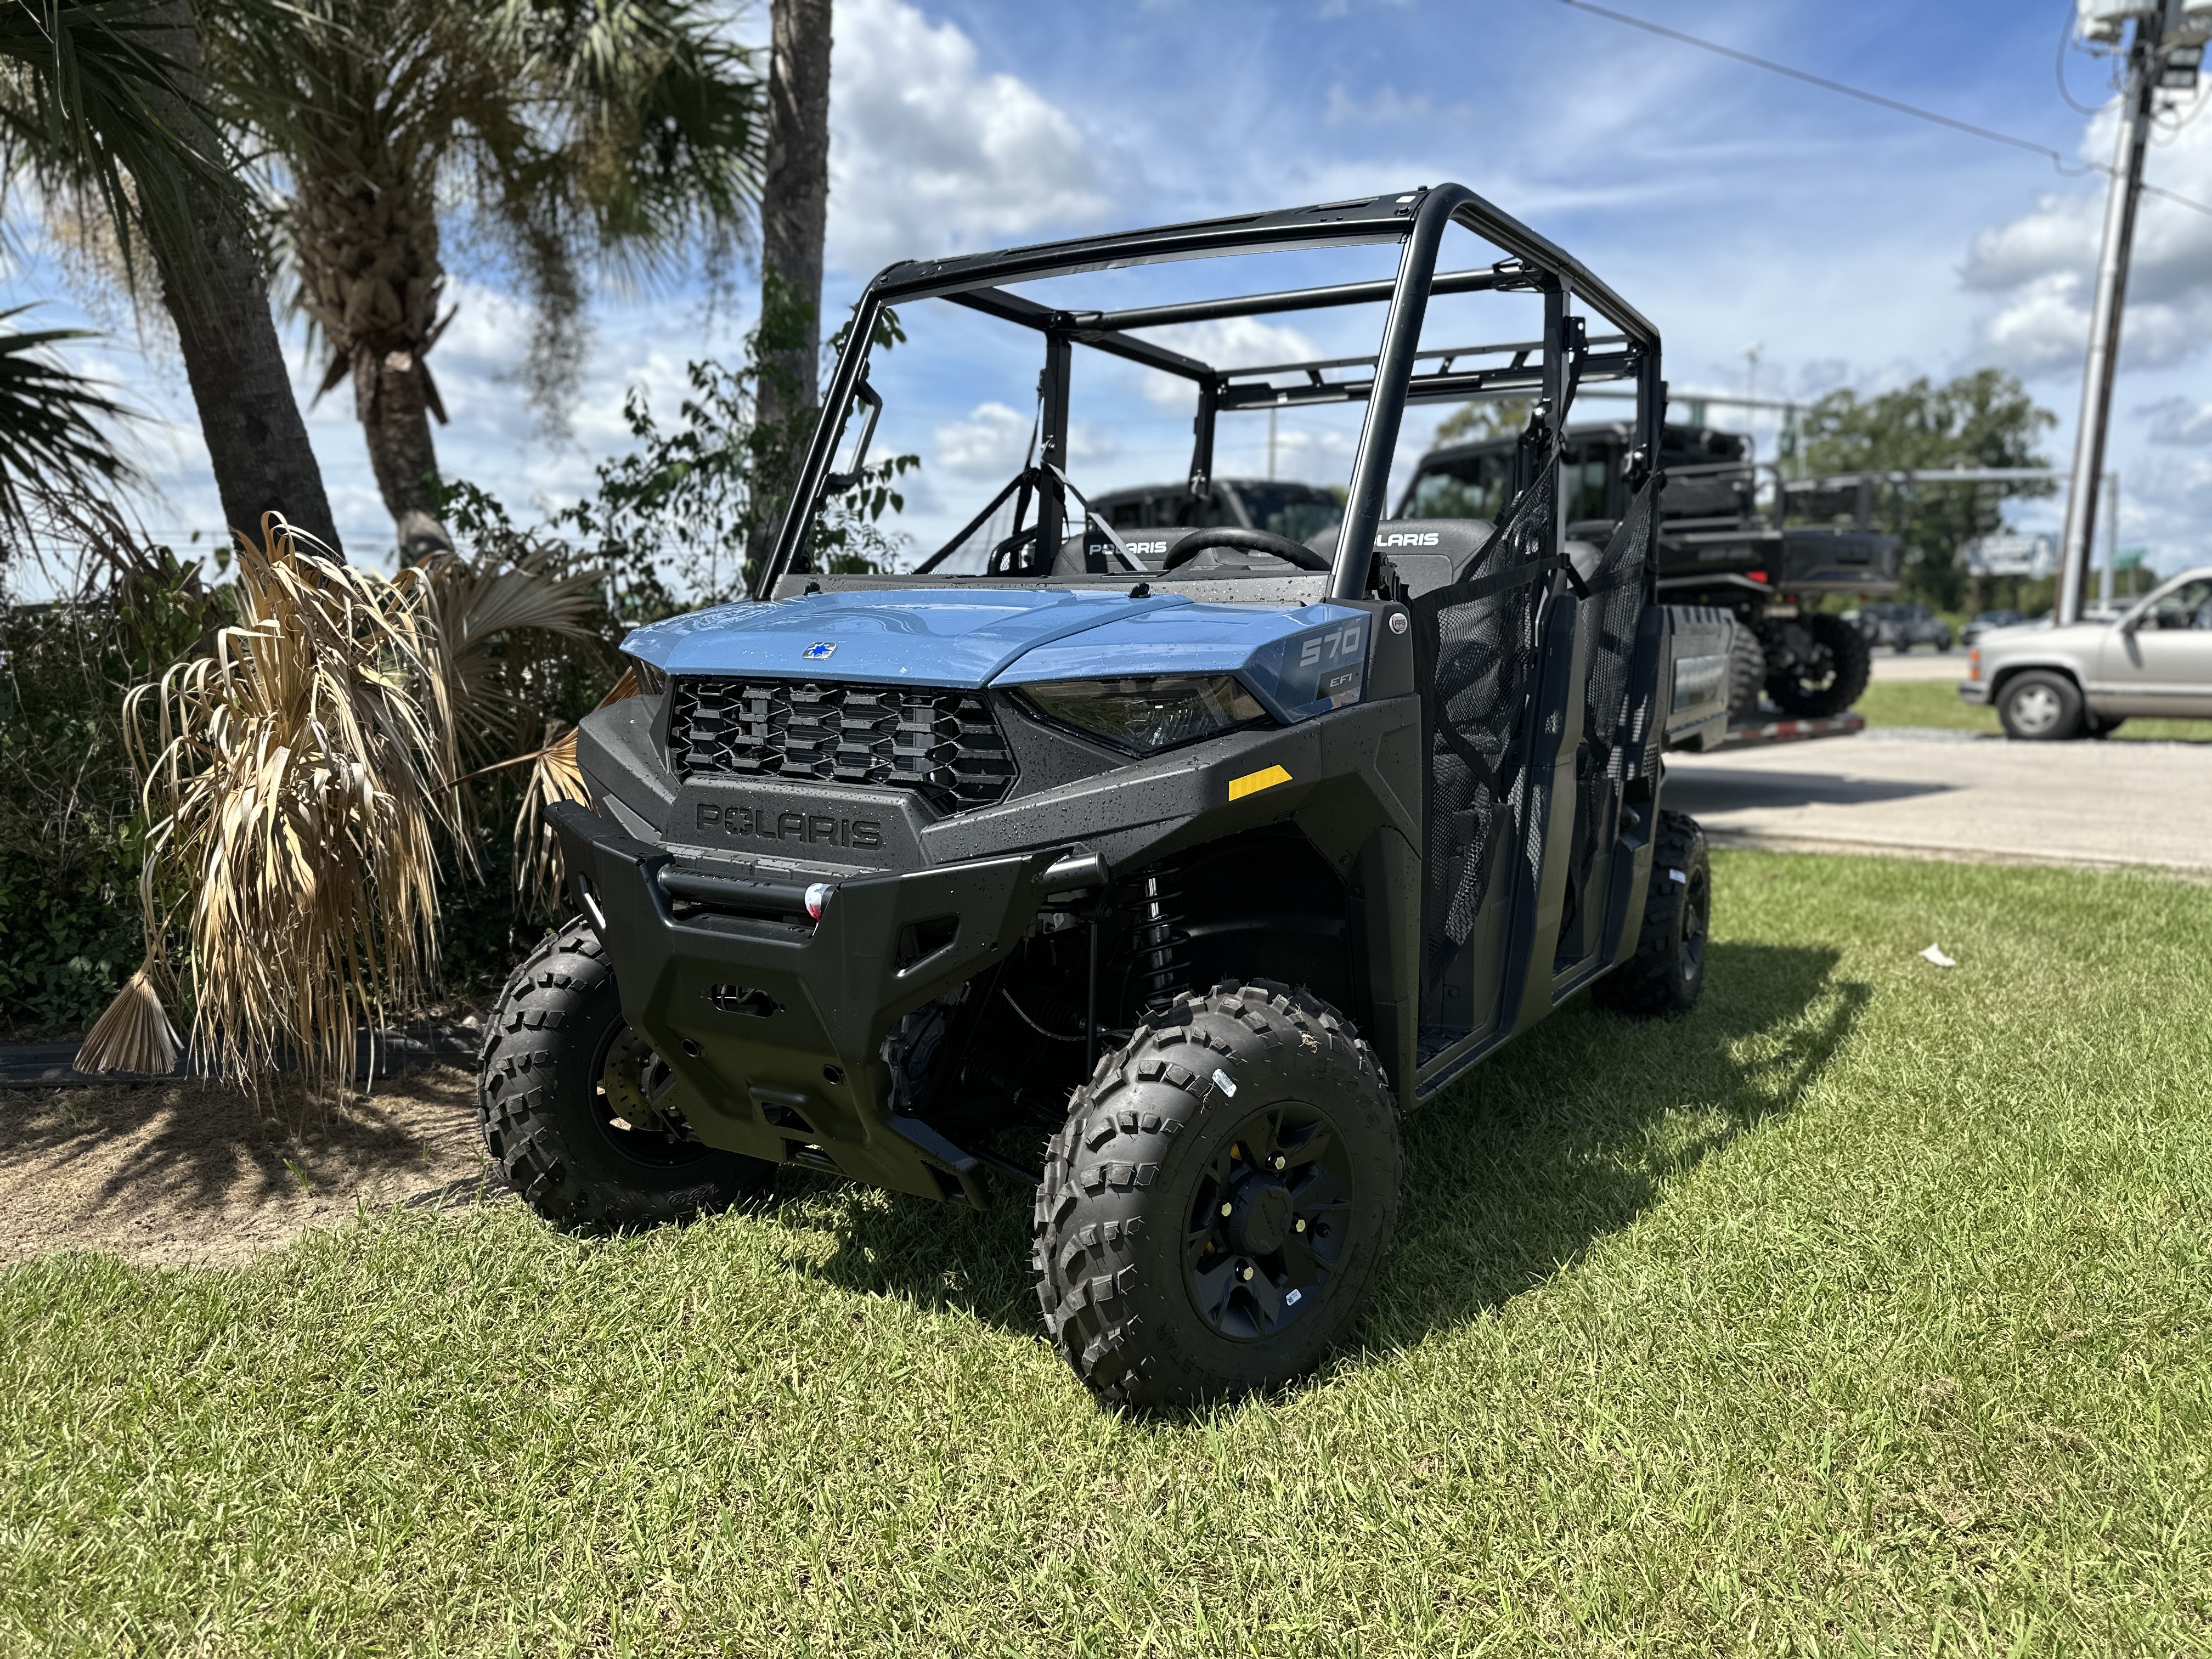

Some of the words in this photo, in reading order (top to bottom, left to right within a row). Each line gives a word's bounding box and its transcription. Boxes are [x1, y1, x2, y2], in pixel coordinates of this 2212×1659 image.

[1374, 533, 1439, 547] LARIS
[1300, 626, 1361, 668] 570
[1329, 673, 1353, 688] EFI
[697, 803, 883, 851] POLARIS
